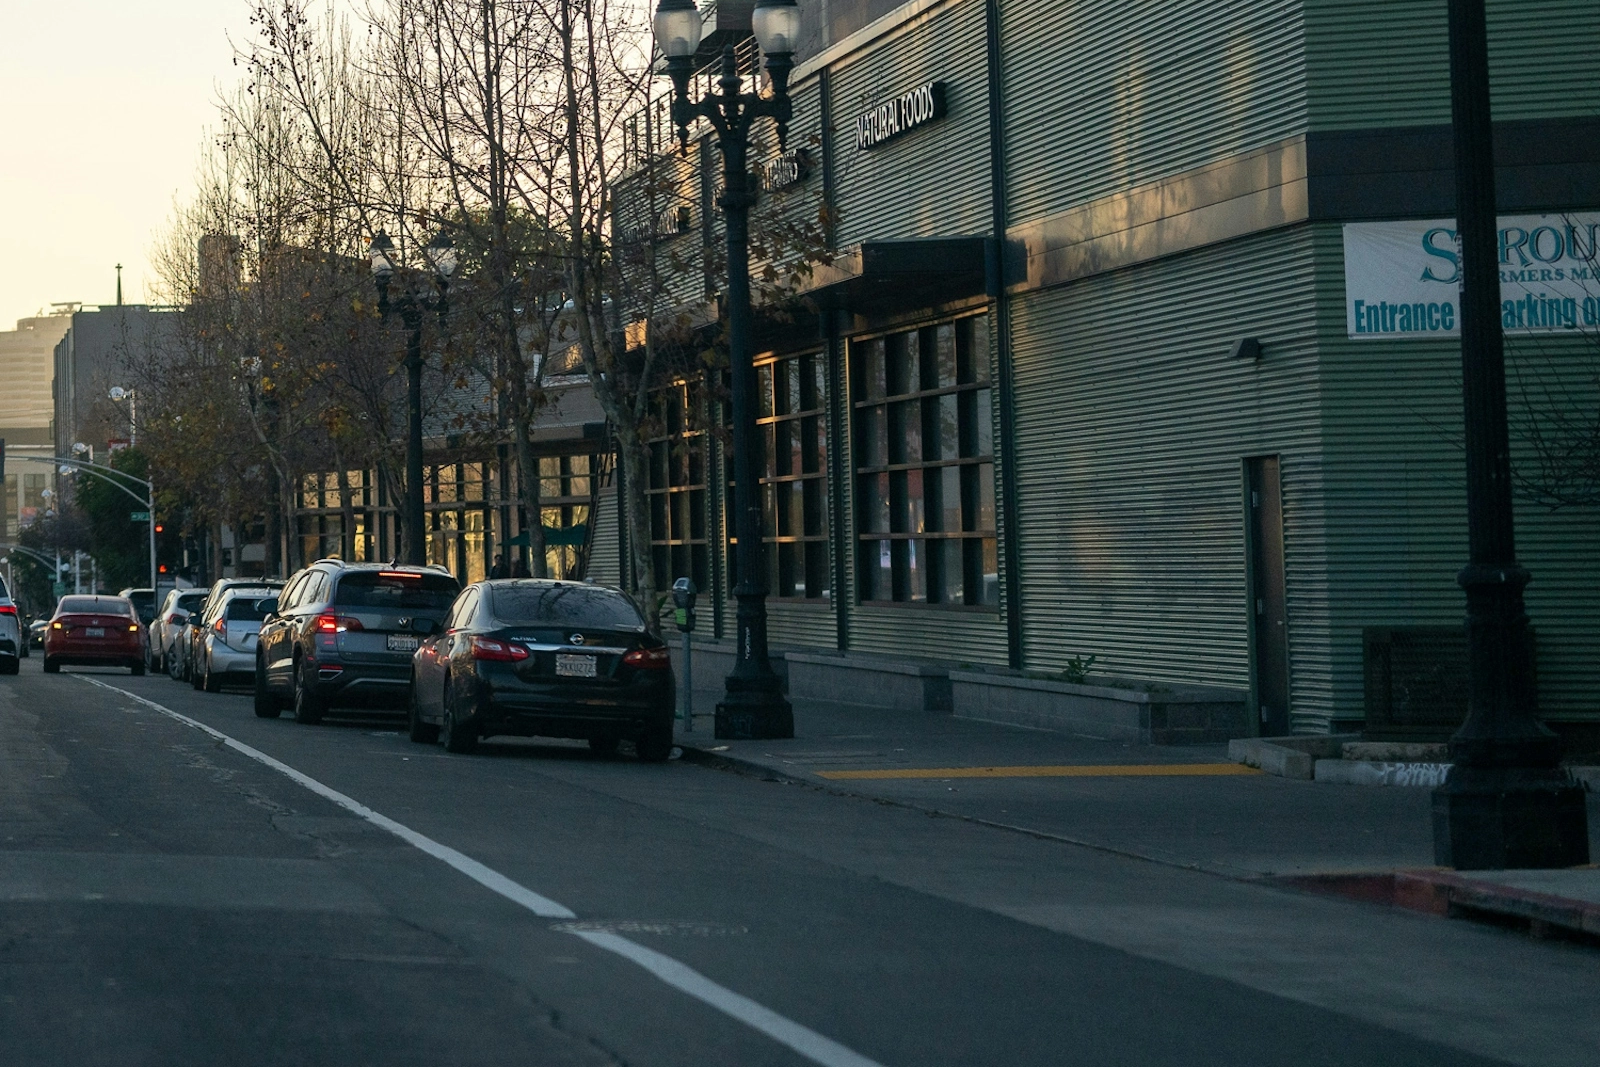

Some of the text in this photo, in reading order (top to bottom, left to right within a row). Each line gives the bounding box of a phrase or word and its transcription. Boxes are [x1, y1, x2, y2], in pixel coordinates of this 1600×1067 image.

[855, 81, 935, 150] NATURAL FOODS
[1420, 223, 1600, 284] SROU
[1499, 267, 1565, 283] RMERS
[1354, 299, 1455, 333] Entrance
[1502, 292, 1578, 330] arking
